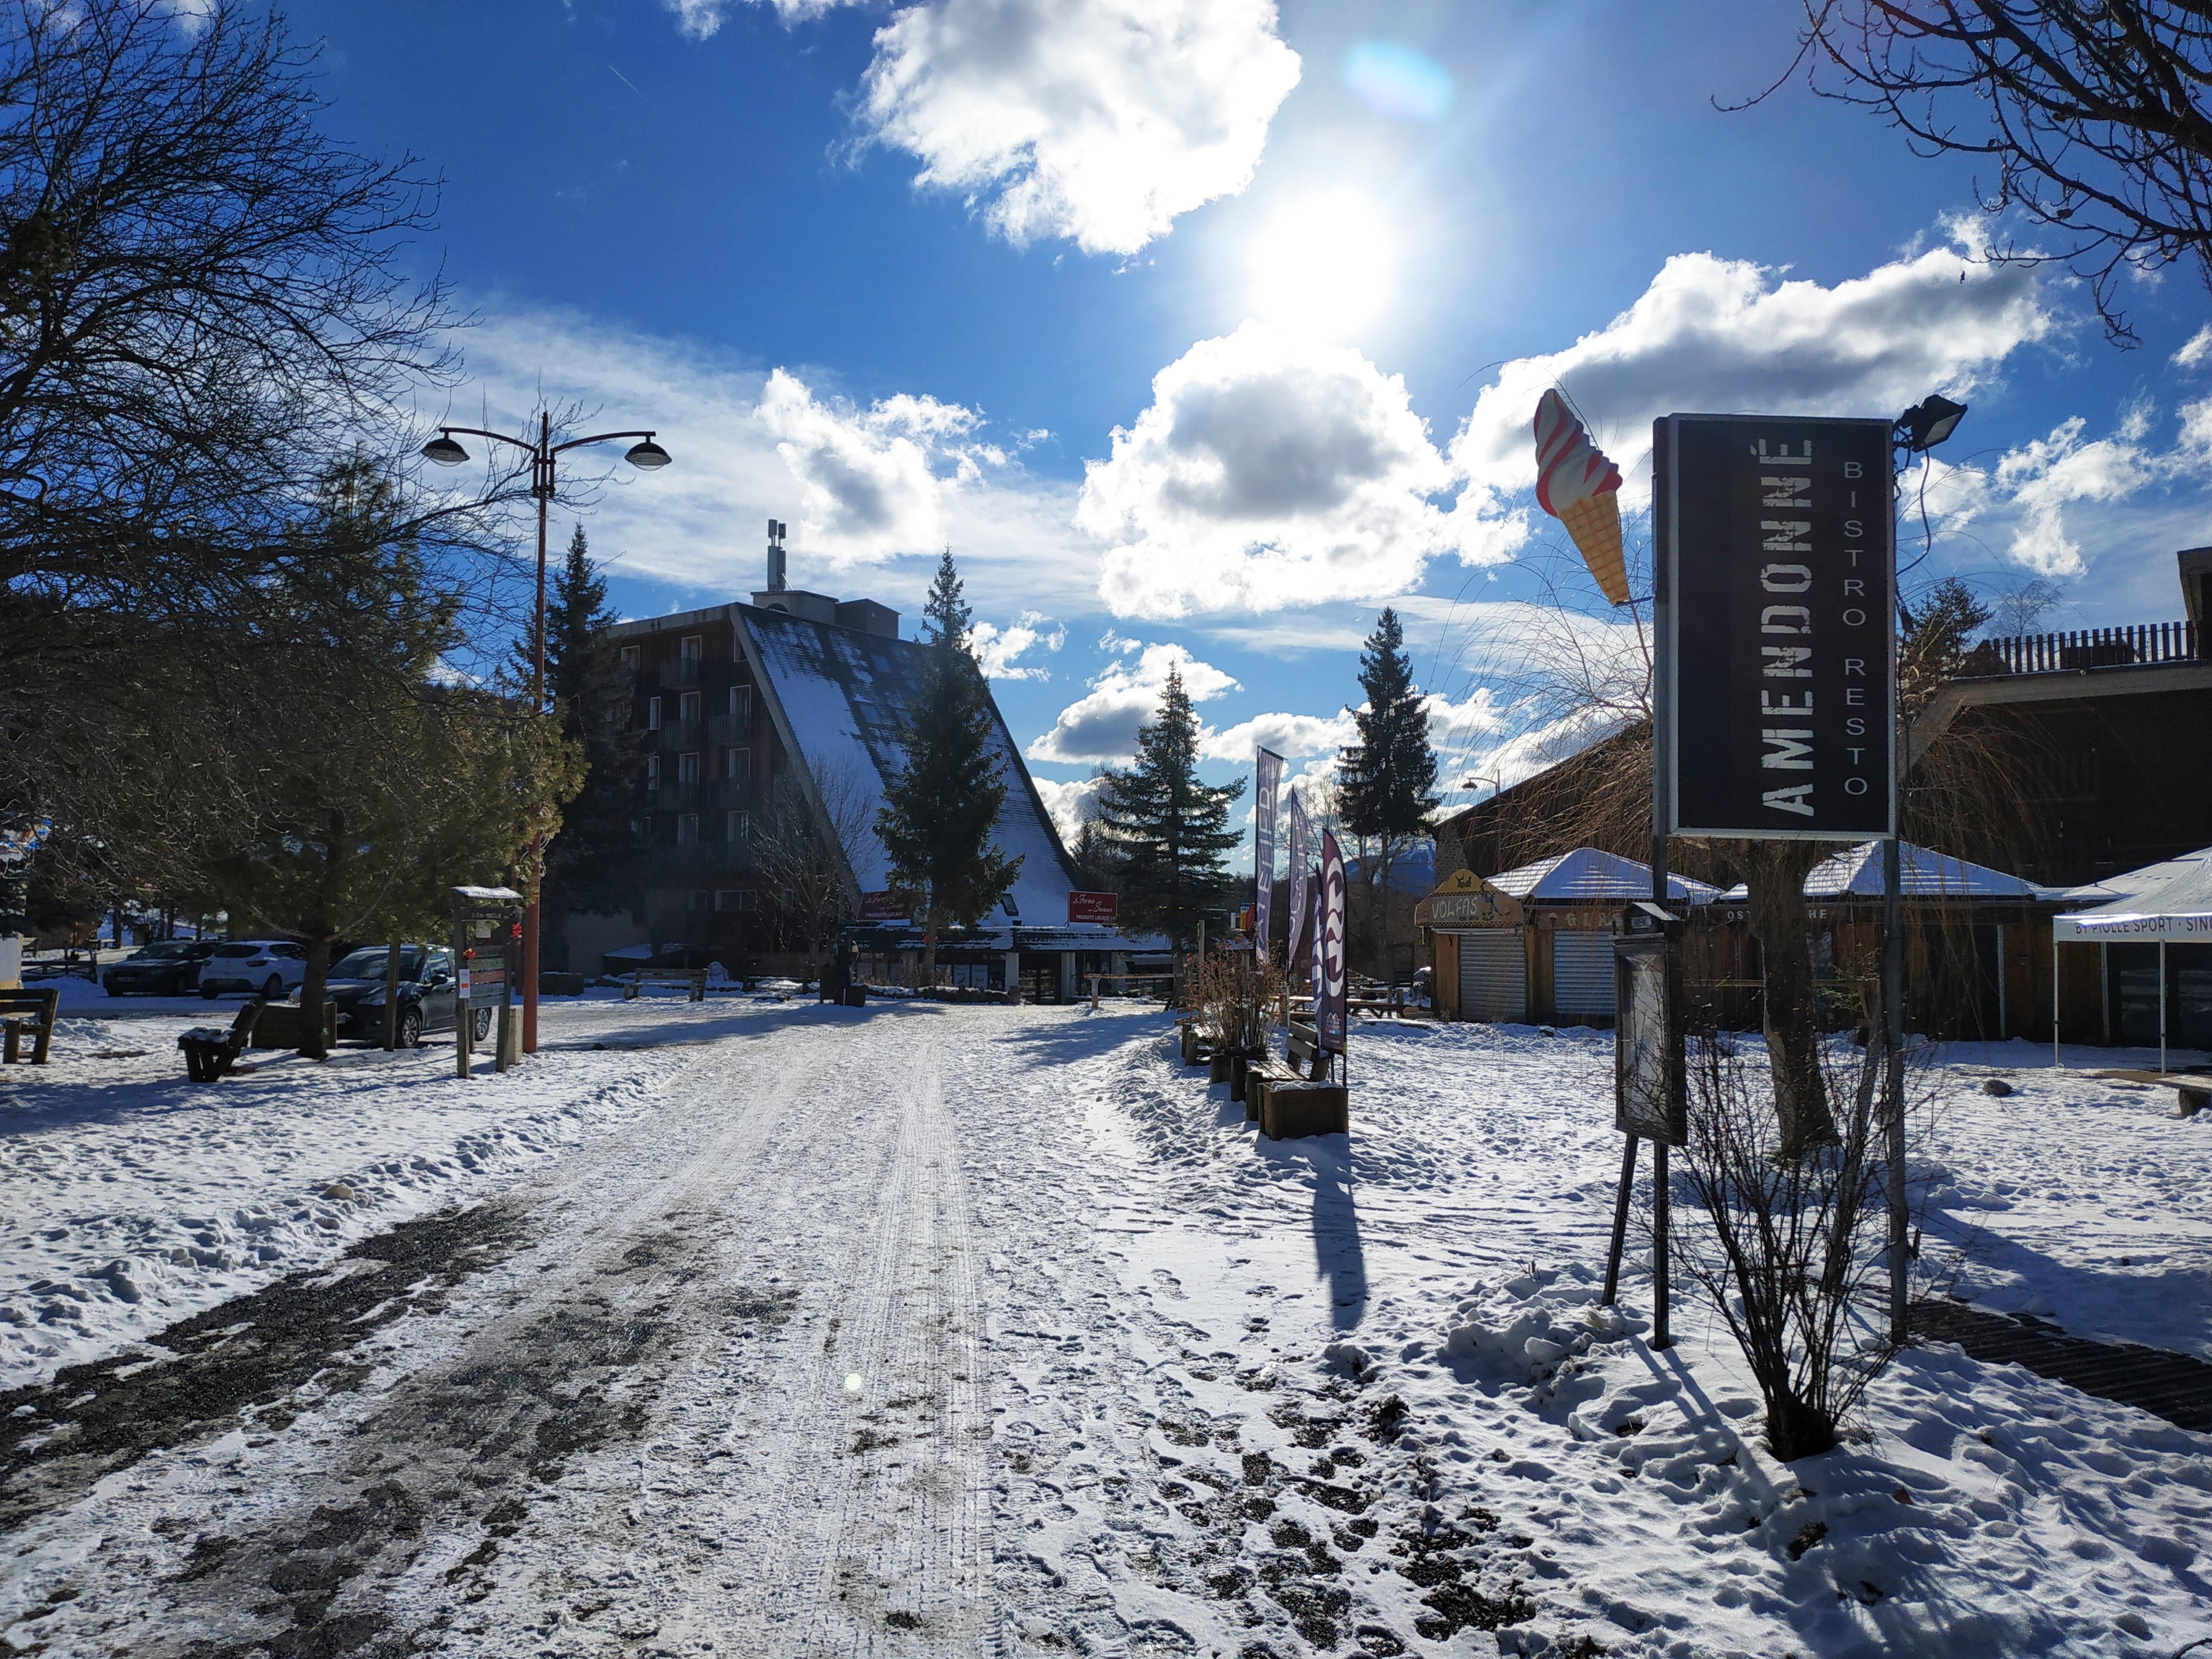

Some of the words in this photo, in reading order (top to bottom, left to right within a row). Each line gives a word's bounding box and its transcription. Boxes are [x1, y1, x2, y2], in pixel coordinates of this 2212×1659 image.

[1842, 461, 1866, 627] BISTRO
[1750, 438, 1815, 817] AMENDONNÉ
[1843, 658, 1869, 795] RESTO
[1431, 896, 1478, 919] VOLFAS
[2132, 917, 2173, 932] SPORT
